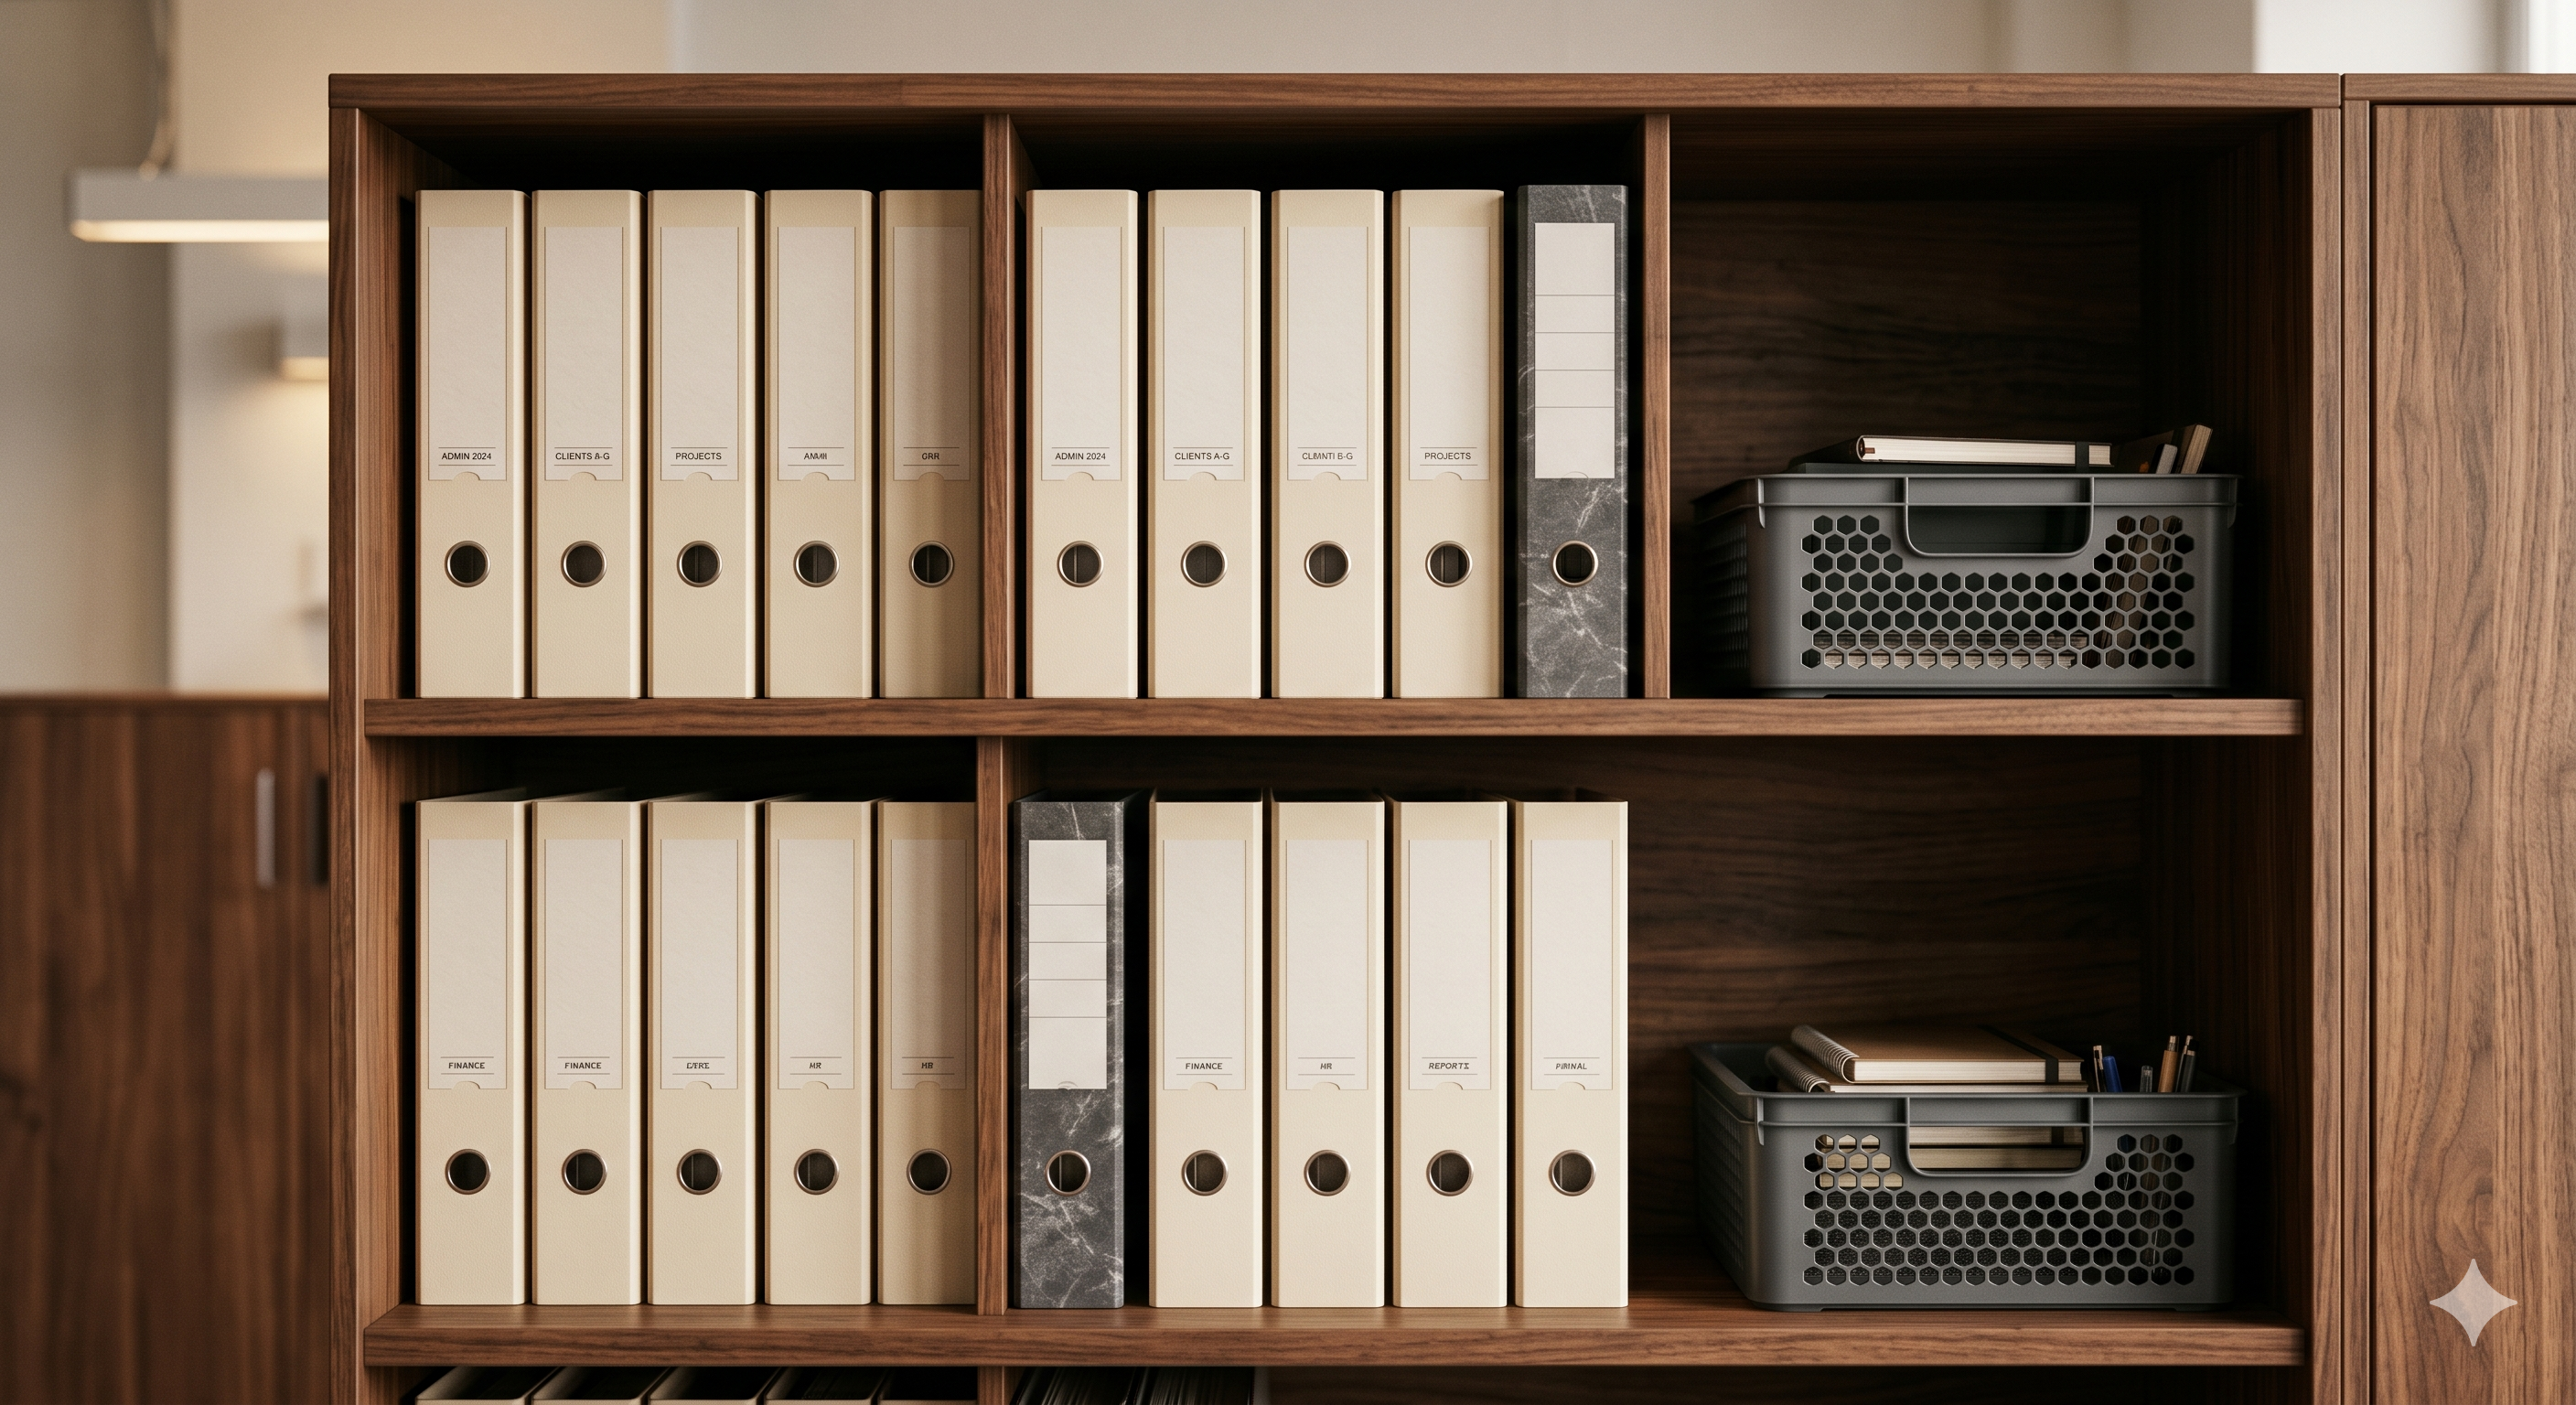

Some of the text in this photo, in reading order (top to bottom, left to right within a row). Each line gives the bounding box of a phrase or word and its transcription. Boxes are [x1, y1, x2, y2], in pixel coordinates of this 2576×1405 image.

[441, 452, 492, 461] ADMIN 2024
[554, 452, 593, 461] CLIENTS
[675, 452, 722, 461] PROJECTS
[1055, 452, 1106, 461] ADMIN 2024
[1175, 452, 1230, 461] CLIENTS A-G
[1424, 452, 1472, 461] PROJECTS
[448, 1061, 486, 1070] FINANCE
[564, 1061, 602, 1070] FINANCE
[1185, 1062, 1223, 1070] FINANCE
